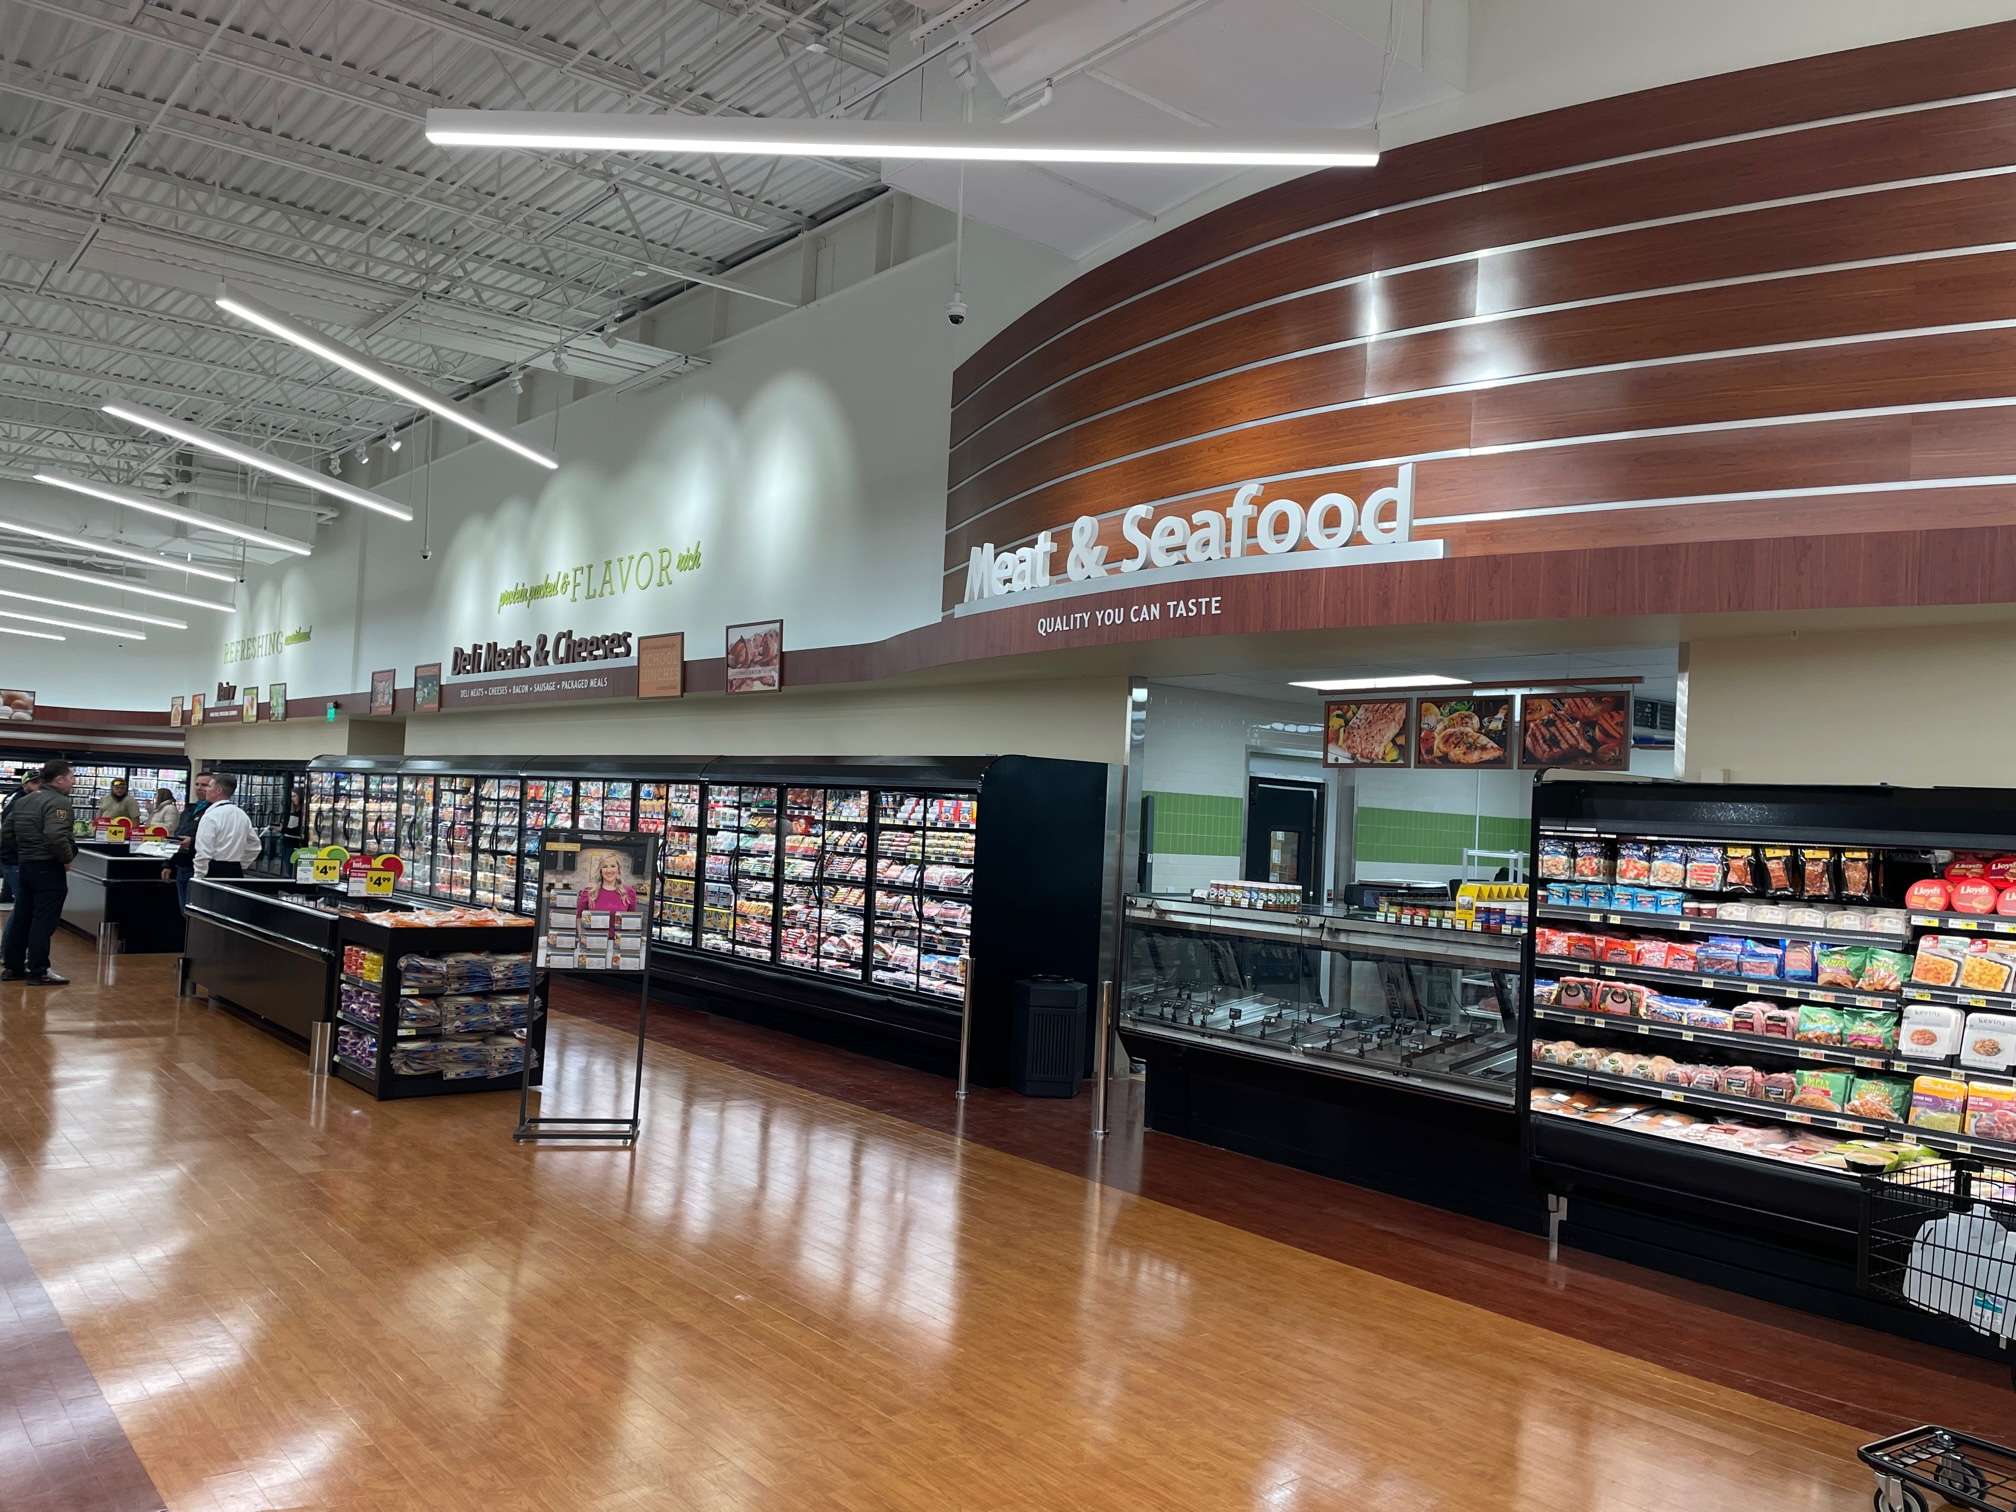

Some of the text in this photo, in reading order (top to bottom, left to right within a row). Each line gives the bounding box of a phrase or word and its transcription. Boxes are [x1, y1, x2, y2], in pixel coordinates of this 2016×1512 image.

[963, 462, 1415, 603] Meat & Seafood
[570, 547, 672, 602] FLAVOR
[1037, 596, 1222, 636] QUALITY YOU CAN TASTE
[223, 631, 284, 664] REFRESHING
[451, 630, 632, 675] Deli Meats & Cheeses
[460, 677, 608, 698] DELI MEATS CHEESES BACON SAUSAGE PACKAGED MEALS
